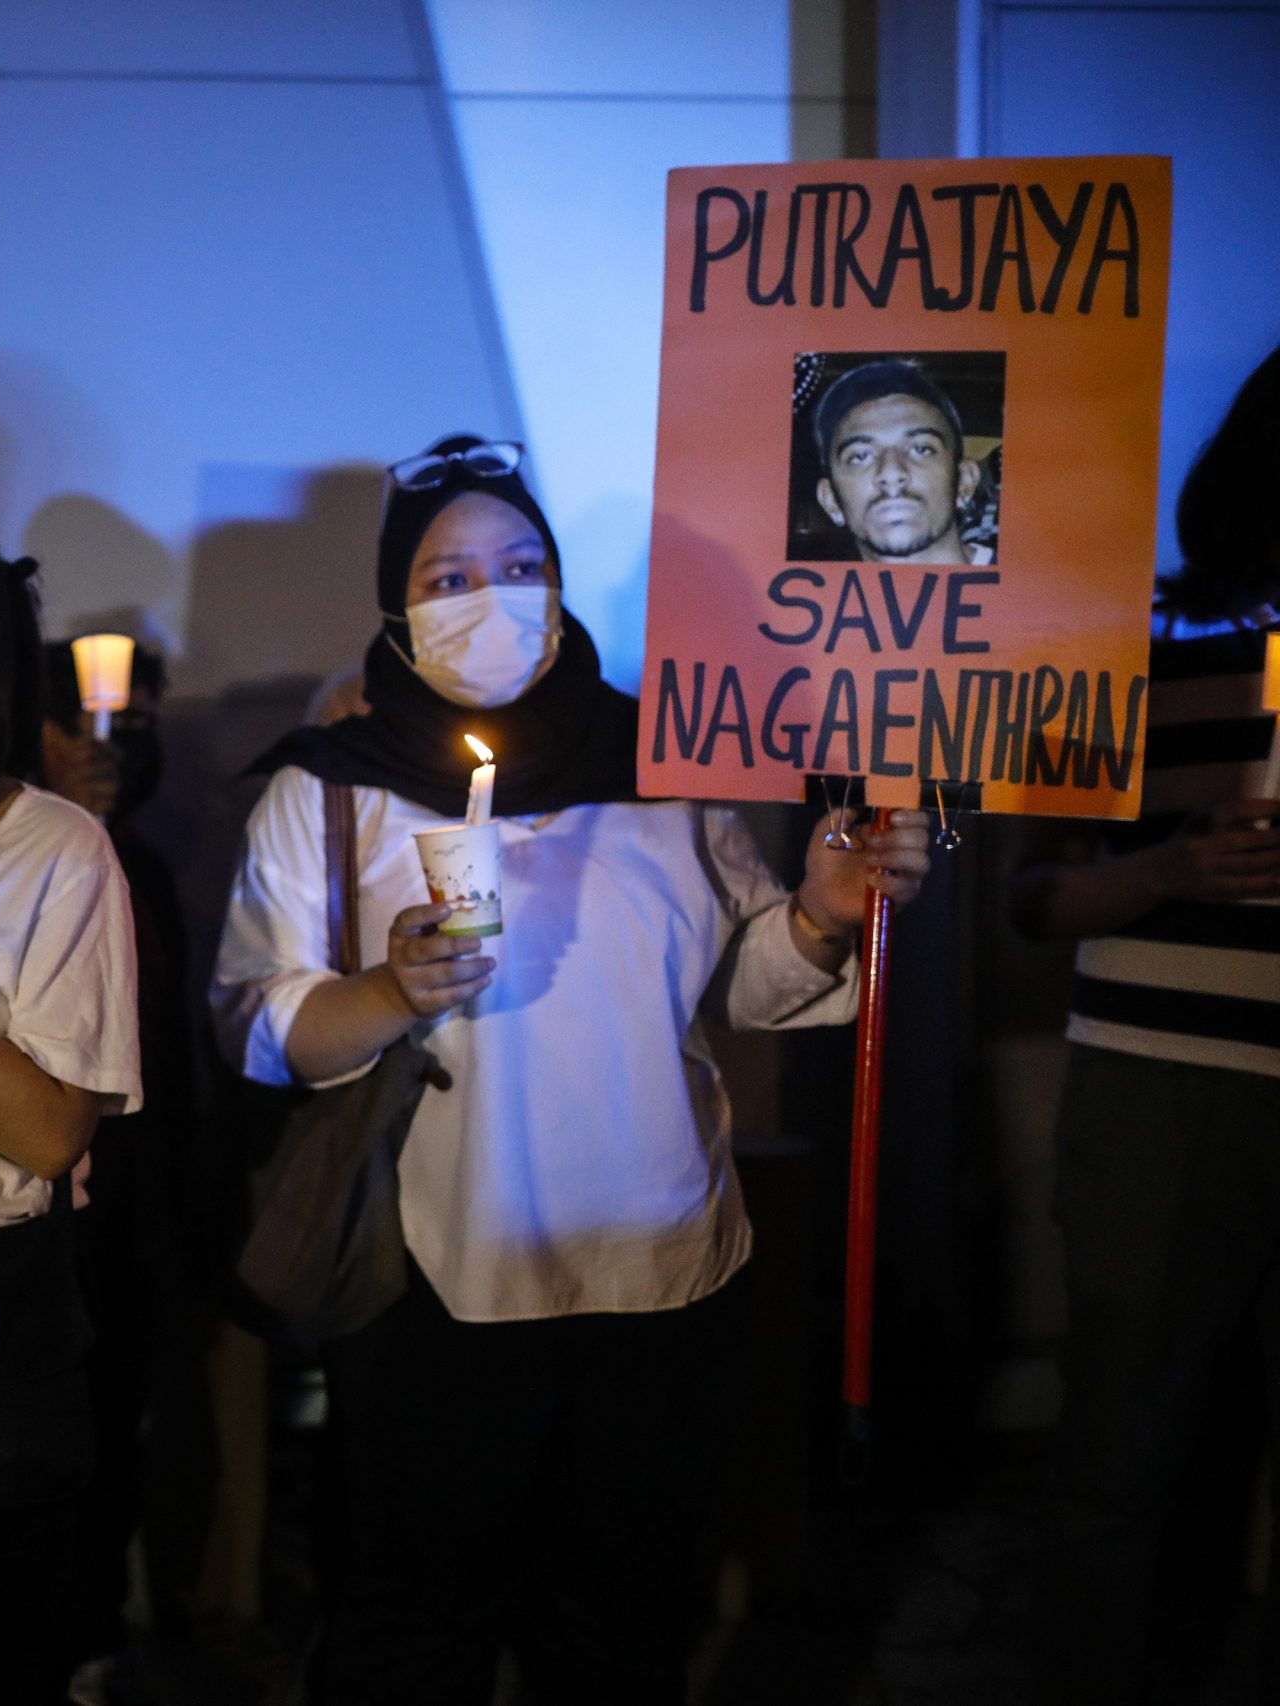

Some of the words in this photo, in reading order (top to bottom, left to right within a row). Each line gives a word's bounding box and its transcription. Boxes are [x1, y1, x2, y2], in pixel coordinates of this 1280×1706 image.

[689, 181, 1141, 318] PUTRAJAYA
[757, 567, 1001, 656] SAVE
[650, 657, 1148, 792] NAGAENTHRAN
